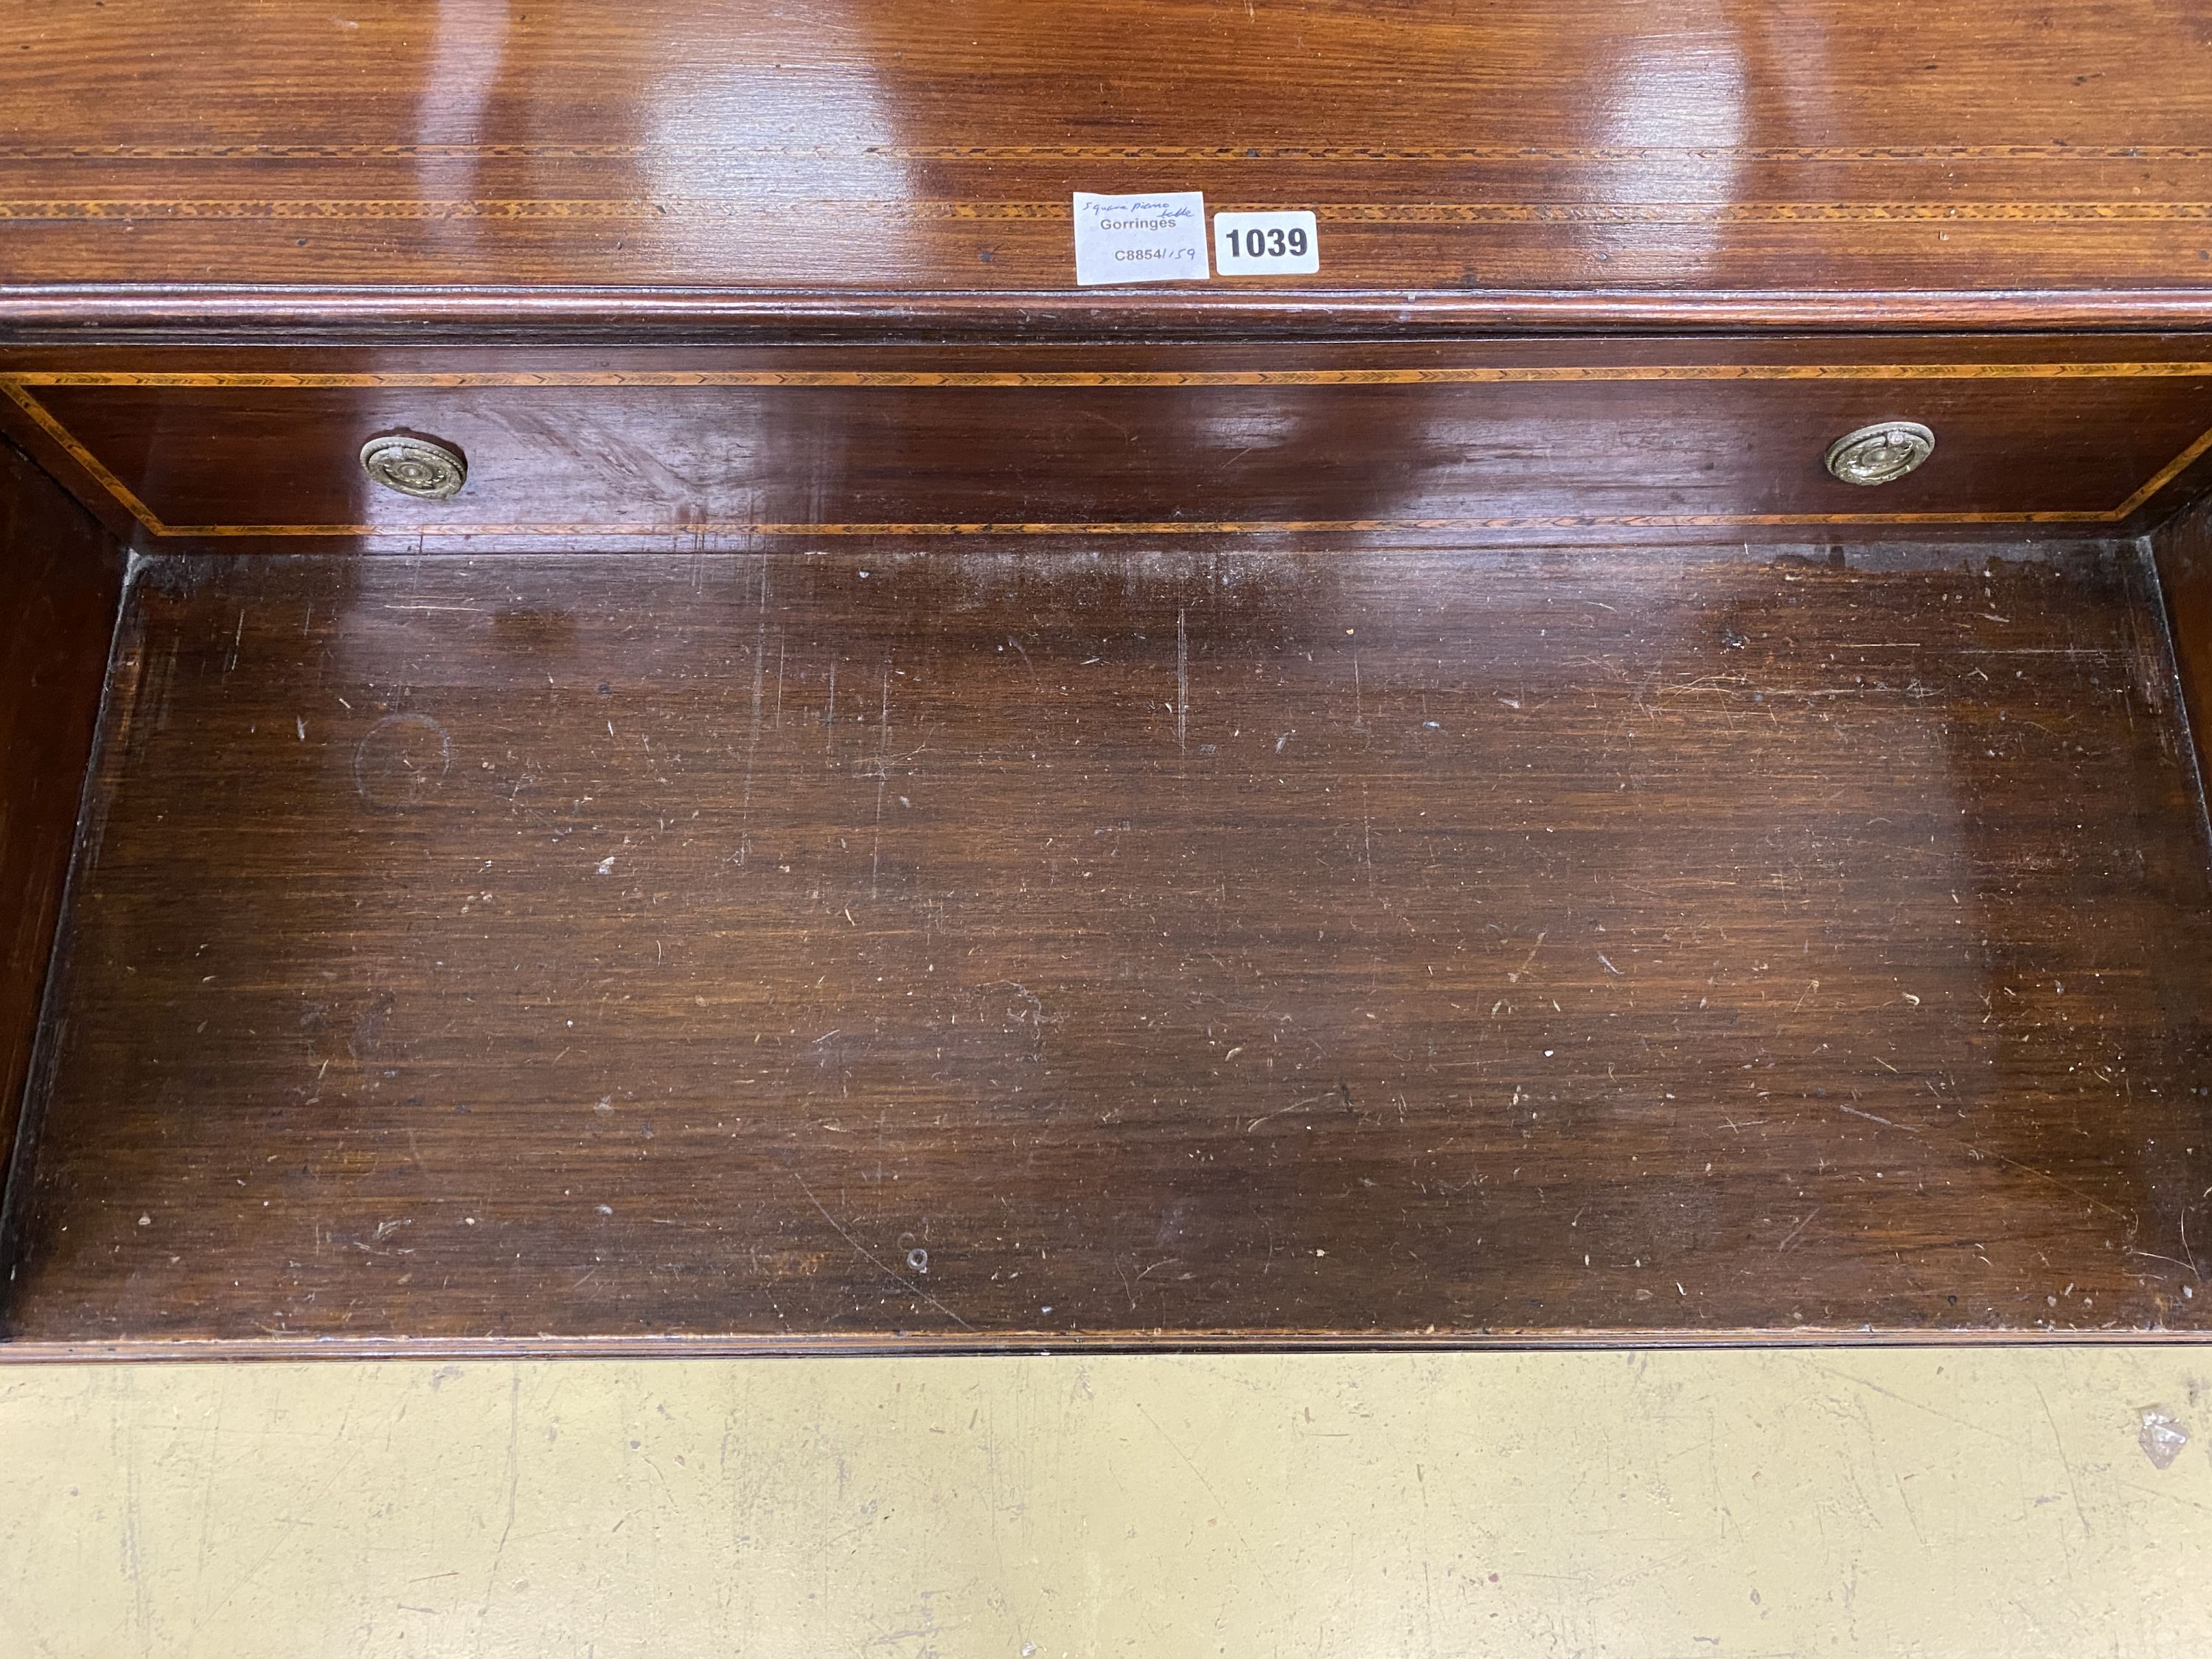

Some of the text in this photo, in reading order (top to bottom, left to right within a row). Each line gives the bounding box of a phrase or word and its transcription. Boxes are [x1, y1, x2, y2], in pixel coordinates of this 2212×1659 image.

[1131, 202, 1169, 212] piano
[1100, 218, 1177, 231] Gorringes
[1225, 228, 1308, 258] 1039
